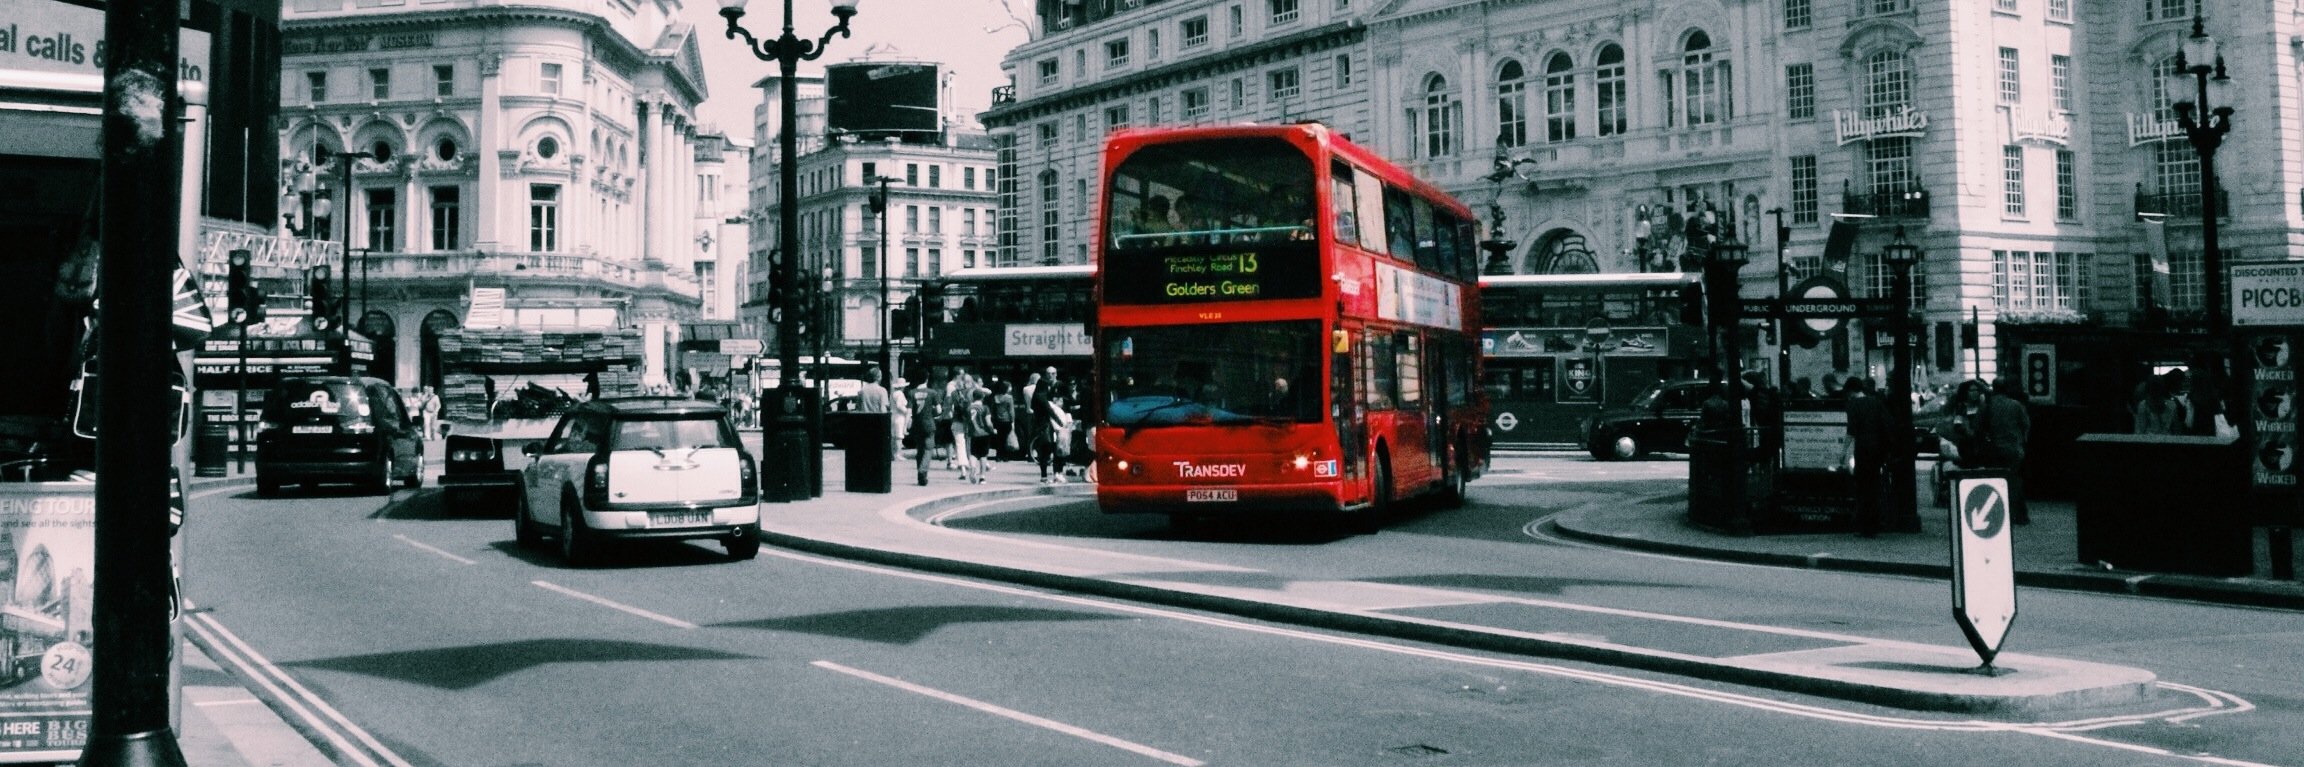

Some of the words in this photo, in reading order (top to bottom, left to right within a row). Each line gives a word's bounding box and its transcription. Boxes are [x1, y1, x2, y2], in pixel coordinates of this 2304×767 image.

[379, 32, 434, 49] MUSEUM
[26, 32, 85, 65] calls
[1833, 103, 1928, 147] Lillywhites
[1170, 263, 1207, 274] Finchley
[1210, 262, 1233, 272] Road
[1239, 252, 1258, 273] 13
[2234, 267, 2298, 278] DISCOUNTED
[1166, 282, 1216, 296] Golders
[1221, 280, 1260, 295] Green
[1785, 304, 1857, 313] UNDERGROUND
[1012, 330, 1072, 350] Straight
[197, 365, 231, 374] HALF
[234, 365, 273, 374] PRICE
[1568, 369, 1591, 377] KING
[1173, 461, 1246, 478] TRANSDEV
[1190, 491, 1213, 500] PO54
[1216, 491, 1234, 500] ACU
[687, 512, 708, 523] UAN
[21, 520, 36, 528] see
[52, 519, 67, 527] the
[70, 519, 95, 530] sights
[50, 654, 75, 674] 24
[3, 722, 41, 735] HERE
[48, 721, 87, 731] BIG
[48, 731, 88, 741] BUS
